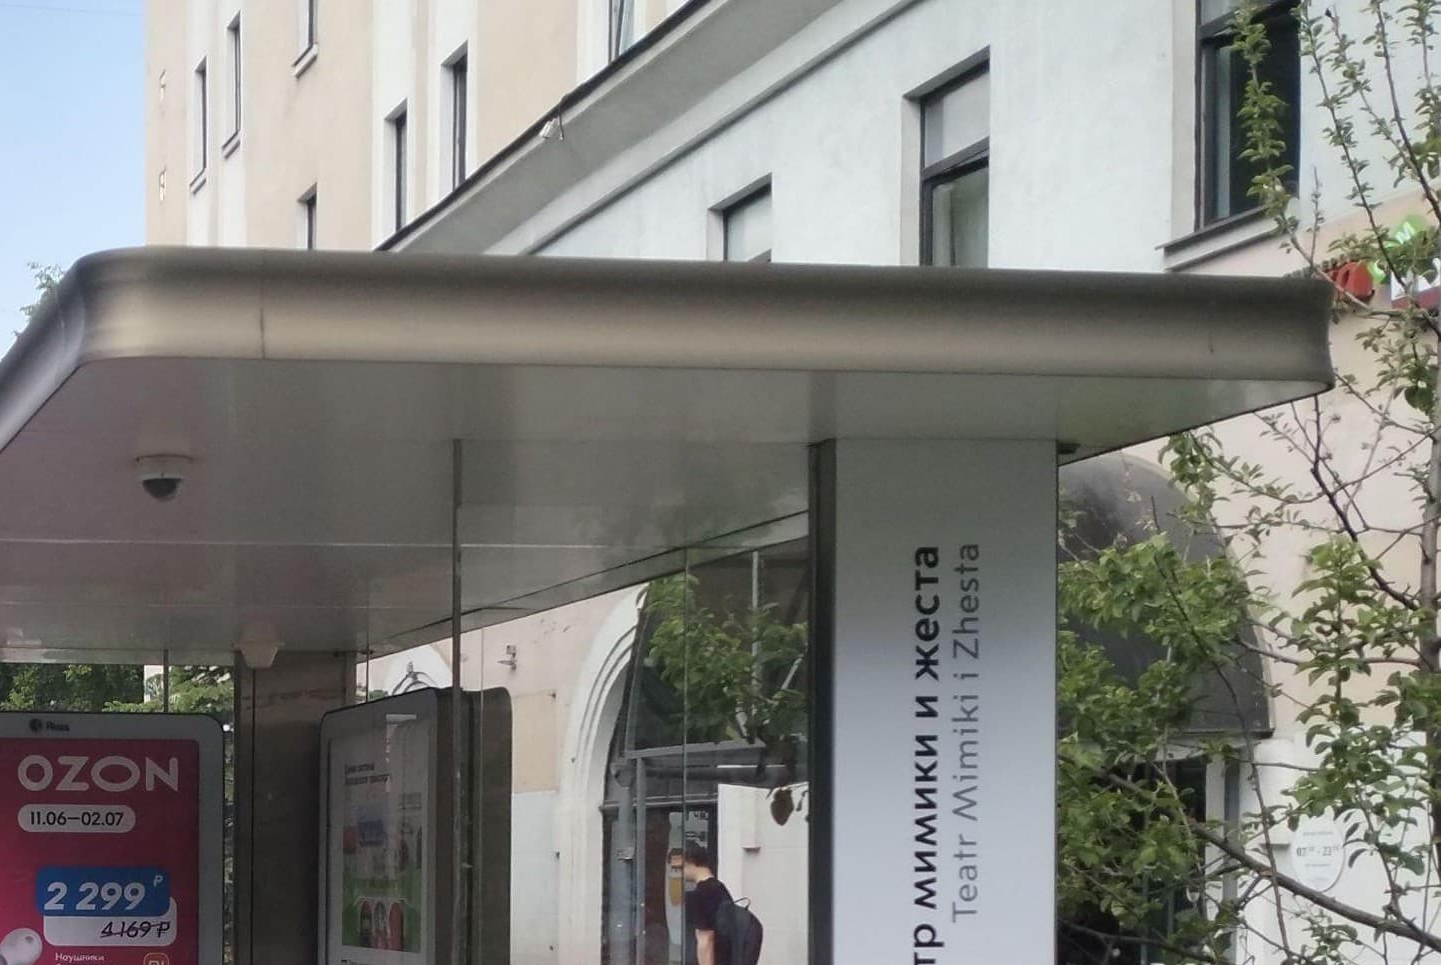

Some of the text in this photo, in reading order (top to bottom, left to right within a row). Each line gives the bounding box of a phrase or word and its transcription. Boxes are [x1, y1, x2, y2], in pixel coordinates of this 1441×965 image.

[913, 545, 940, 682] жеста
[914, 694, 939, 719] и
[951, 543, 980, 923] Teatr Mimiki i Zhesta
[17, 754, 179, 792] OZON
[913, 733, 938, 909] мимики
[75, 882, 146, 910] 299
[55, 952, 105, 963] Наушники
